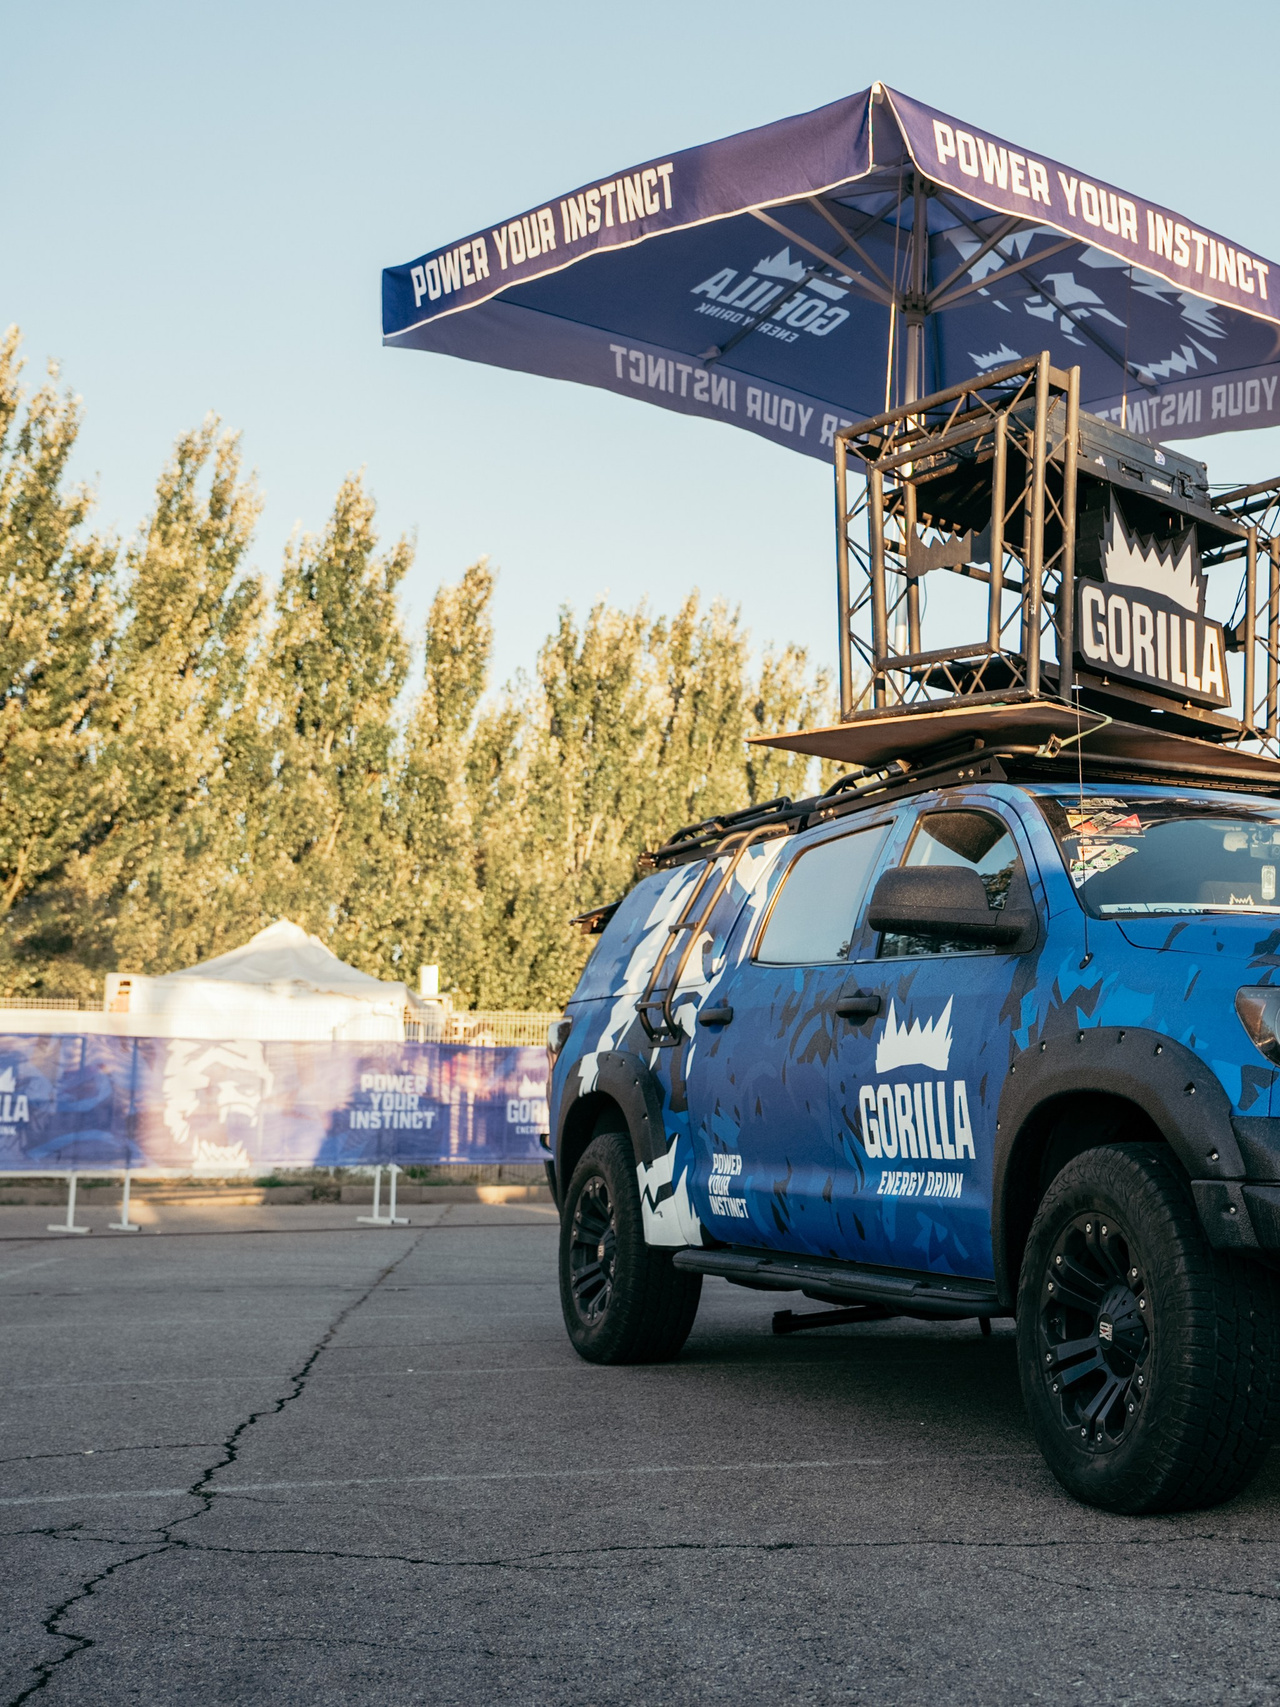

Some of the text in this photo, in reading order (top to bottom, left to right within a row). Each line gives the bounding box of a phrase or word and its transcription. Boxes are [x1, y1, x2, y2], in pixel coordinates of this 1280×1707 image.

[933, 119, 1270, 300] POWER YOUR INSTINCT
[410, 162, 673, 308] POWER YOUR INSTINCT
[1082, 585, 1225, 698] GORILLA
[360, 1074, 428, 1093] POWER
[370, 1093, 419, 1111] YOUR
[350, 1111, 436, 1129] INSTINCT
[859, 1080, 976, 1160] GORILLA
[711, 1153, 742, 1175] POWER
[708, 1174, 731, 1196] YOUR
[876, 1171, 963, 1198] ENERGY DRINK
[708, 1195, 749, 1218] INSTINCT
